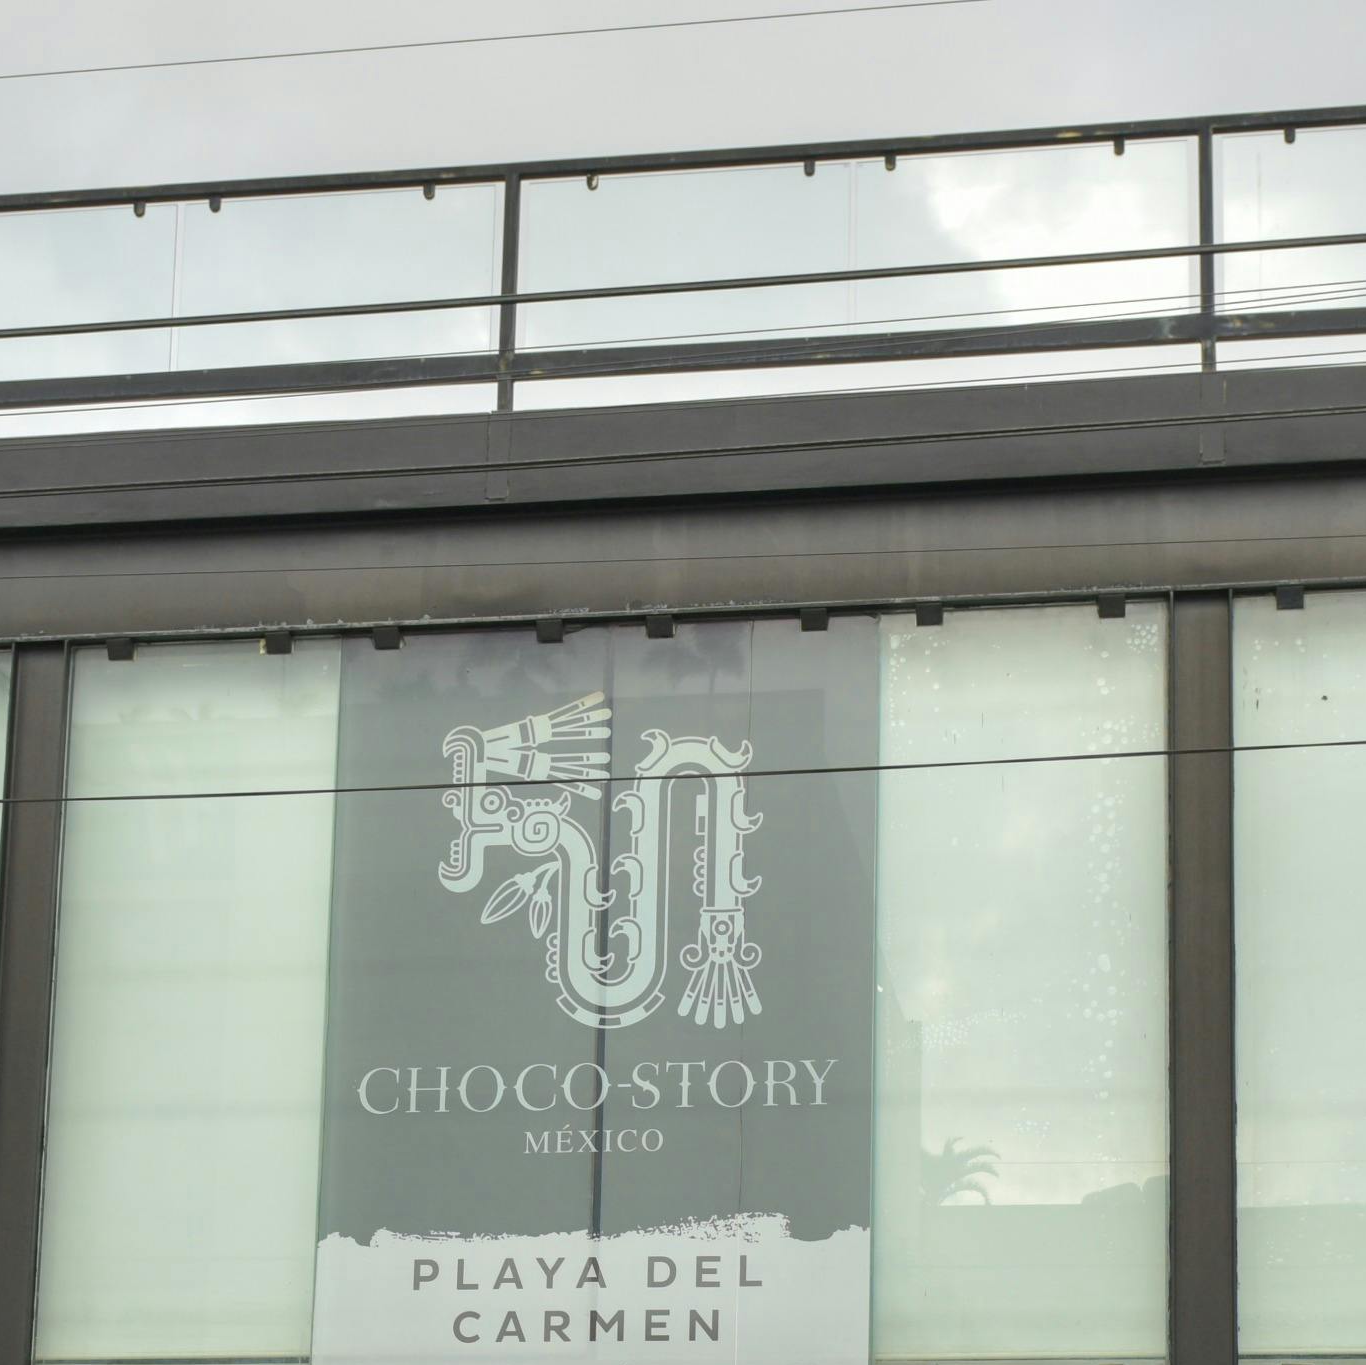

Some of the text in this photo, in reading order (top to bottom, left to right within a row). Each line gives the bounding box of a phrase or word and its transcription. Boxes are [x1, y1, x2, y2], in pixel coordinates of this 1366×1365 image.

[353, 1059, 840, 1115] CHOCO-STORY
[523, 1122, 664, 1155] MÉXICO
[413, 1255, 763, 1291] PLAYA DEL
[452, 1309, 720, 1344] CARMEN
